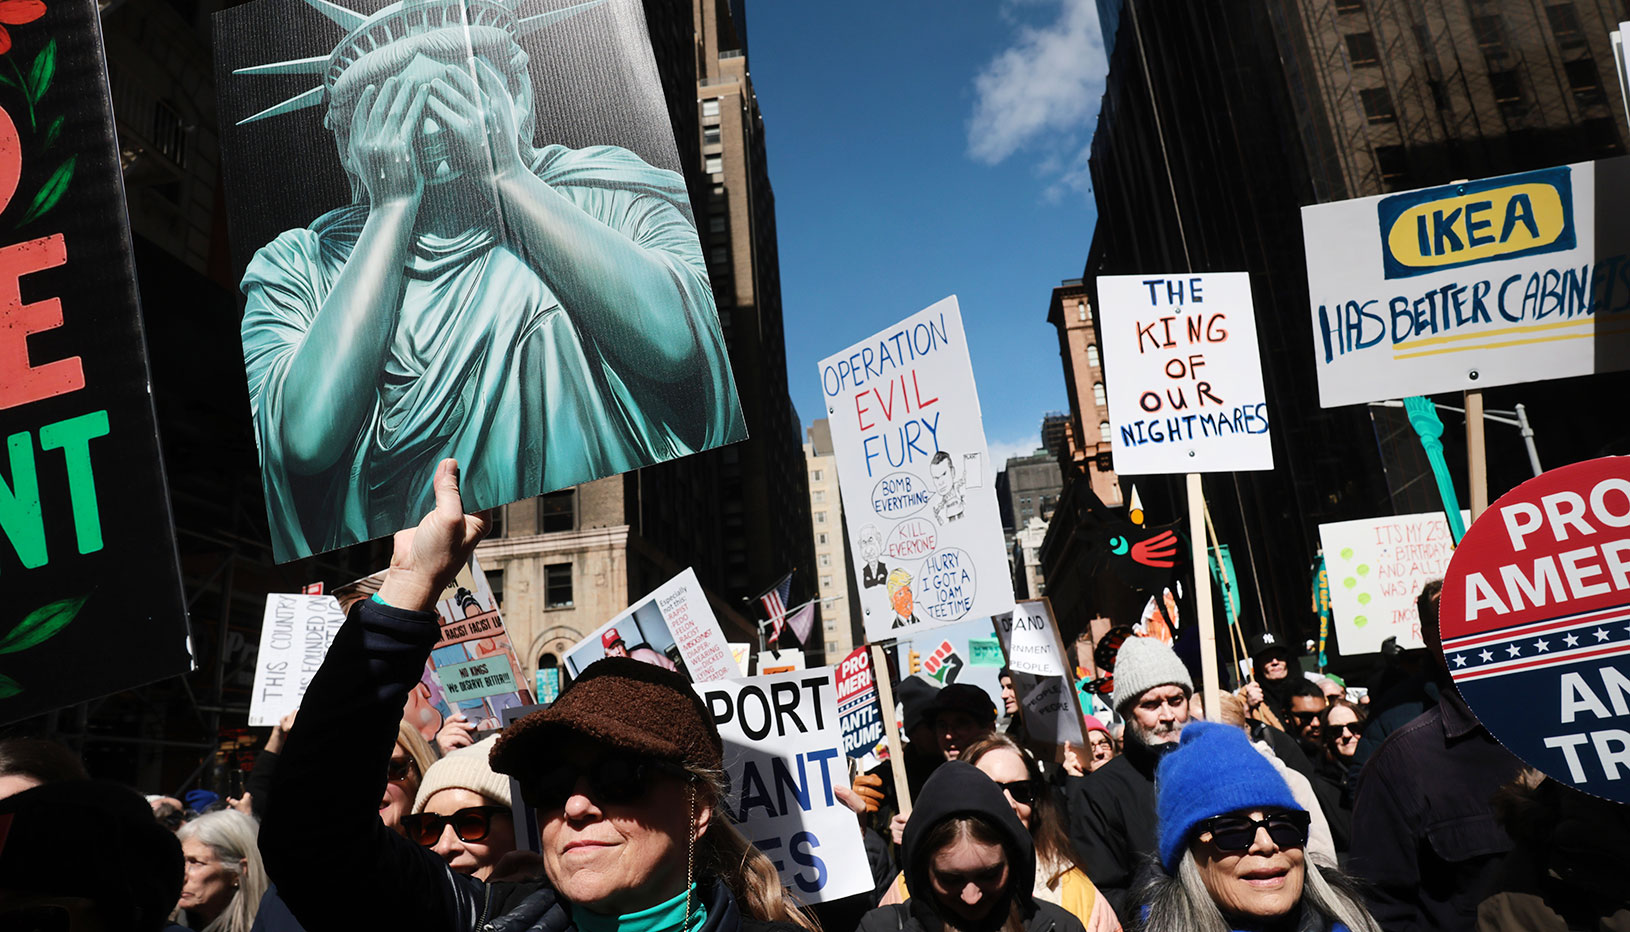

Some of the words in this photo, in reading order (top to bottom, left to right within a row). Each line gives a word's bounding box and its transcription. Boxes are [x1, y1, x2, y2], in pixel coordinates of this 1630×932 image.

[1416, 193, 1540, 257] IKEA
[1142, 277, 1203, 306] THE
[1136, 313, 1229, 354] KING
[1318, 299, 1385, 364] HAS
[1389, 280, 1493, 344] BETTER
[823, 312, 948, 397] OPERATION
[1165, 354, 1206, 380] OF
[855, 369, 939, 431] EVIL
[1139, 381, 1224, 413] OUR
[1120, 402, 1270, 447] NIGHTMARES
[863, 411, 940, 477] FURY
[881, 477, 912, 496] BOMB
[874, 490, 929, 513] EVERYTHING
[1500, 477, 1630, 552] PRO
[899, 522, 926, 538] KILL
[1405, 524, 1423, 546] MY
[889, 535, 936, 558] EVERYONE
[1395, 543, 1447, 561] BIRTHDAY
[926, 551, 960, 574] HURRY
[1378, 563, 1406, 579] AND
[922, 577, 930, 592] I
[933, 572, 956, 590] GOT
[961, 568, 971, 584] A
[1380, 580, 1407, 598] WAS
[659, 586, 688, 607] Especially
[936, 586, 963, 603] 10AM
[663, 603, 674, 614] not
[928, 602, 947, 618] TEE
[947, 597, 971, 617] TIME
[270, 595, 297, 650] COUNTRY
[444, 624, 468, 641] RACIST
[301, 615, 326, 673] FOUNDED
[458, 667, 469, 678] NO
[469, 663, 489, 677] KINGS
[841, 651, 869, 679] PRO
[262, 661, 288, 703] THIS
[446, 682, 460, 694] We
[460, 678, 484, 691] DESERVE
[704, 675, 830, 742] PORT
[724, 747, 839, 825] ANT
